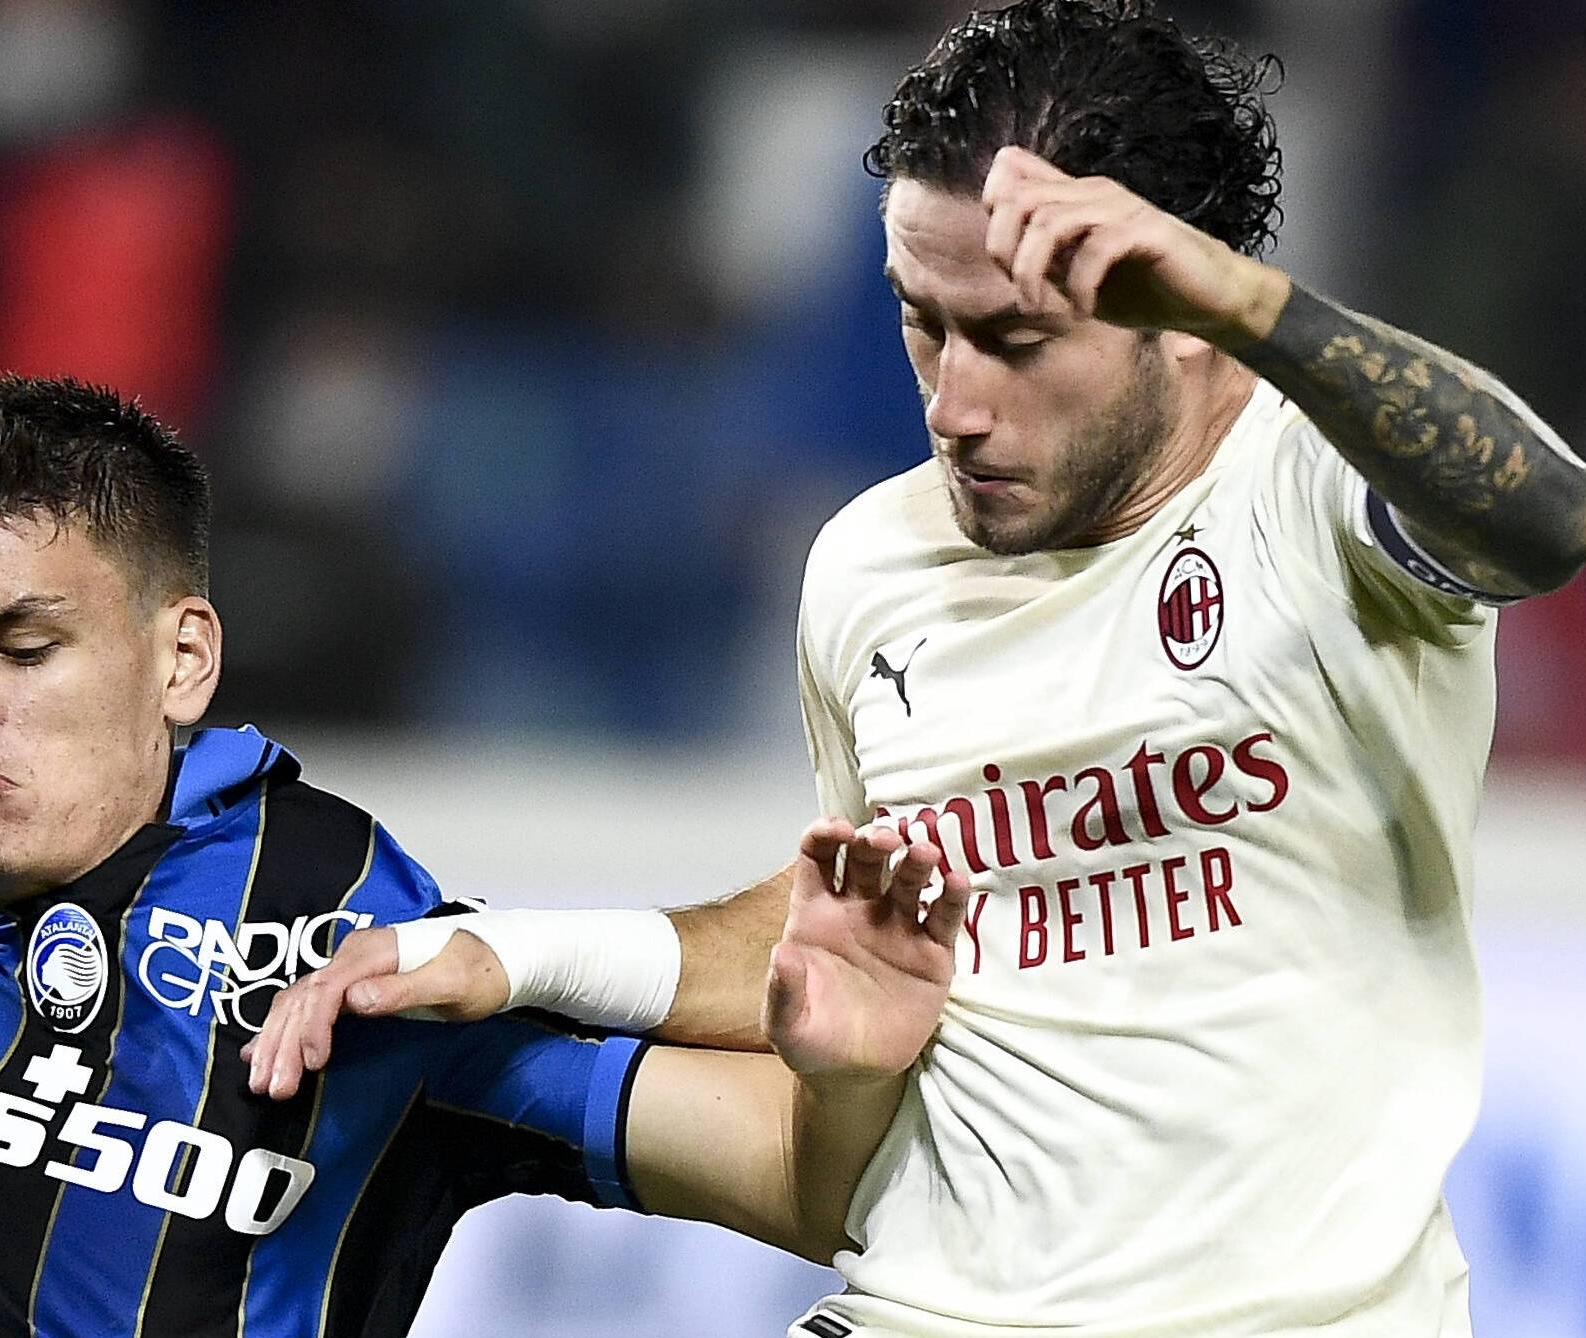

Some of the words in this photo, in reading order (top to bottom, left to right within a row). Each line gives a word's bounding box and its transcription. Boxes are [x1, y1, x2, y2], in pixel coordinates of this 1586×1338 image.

[877, 733, 1290, 887] mirates
[40, 921, 96, 940] ATALANTA
[1018, 847, 1243, 970] BETTER
[49, 1005, 83, 1020] 1907
